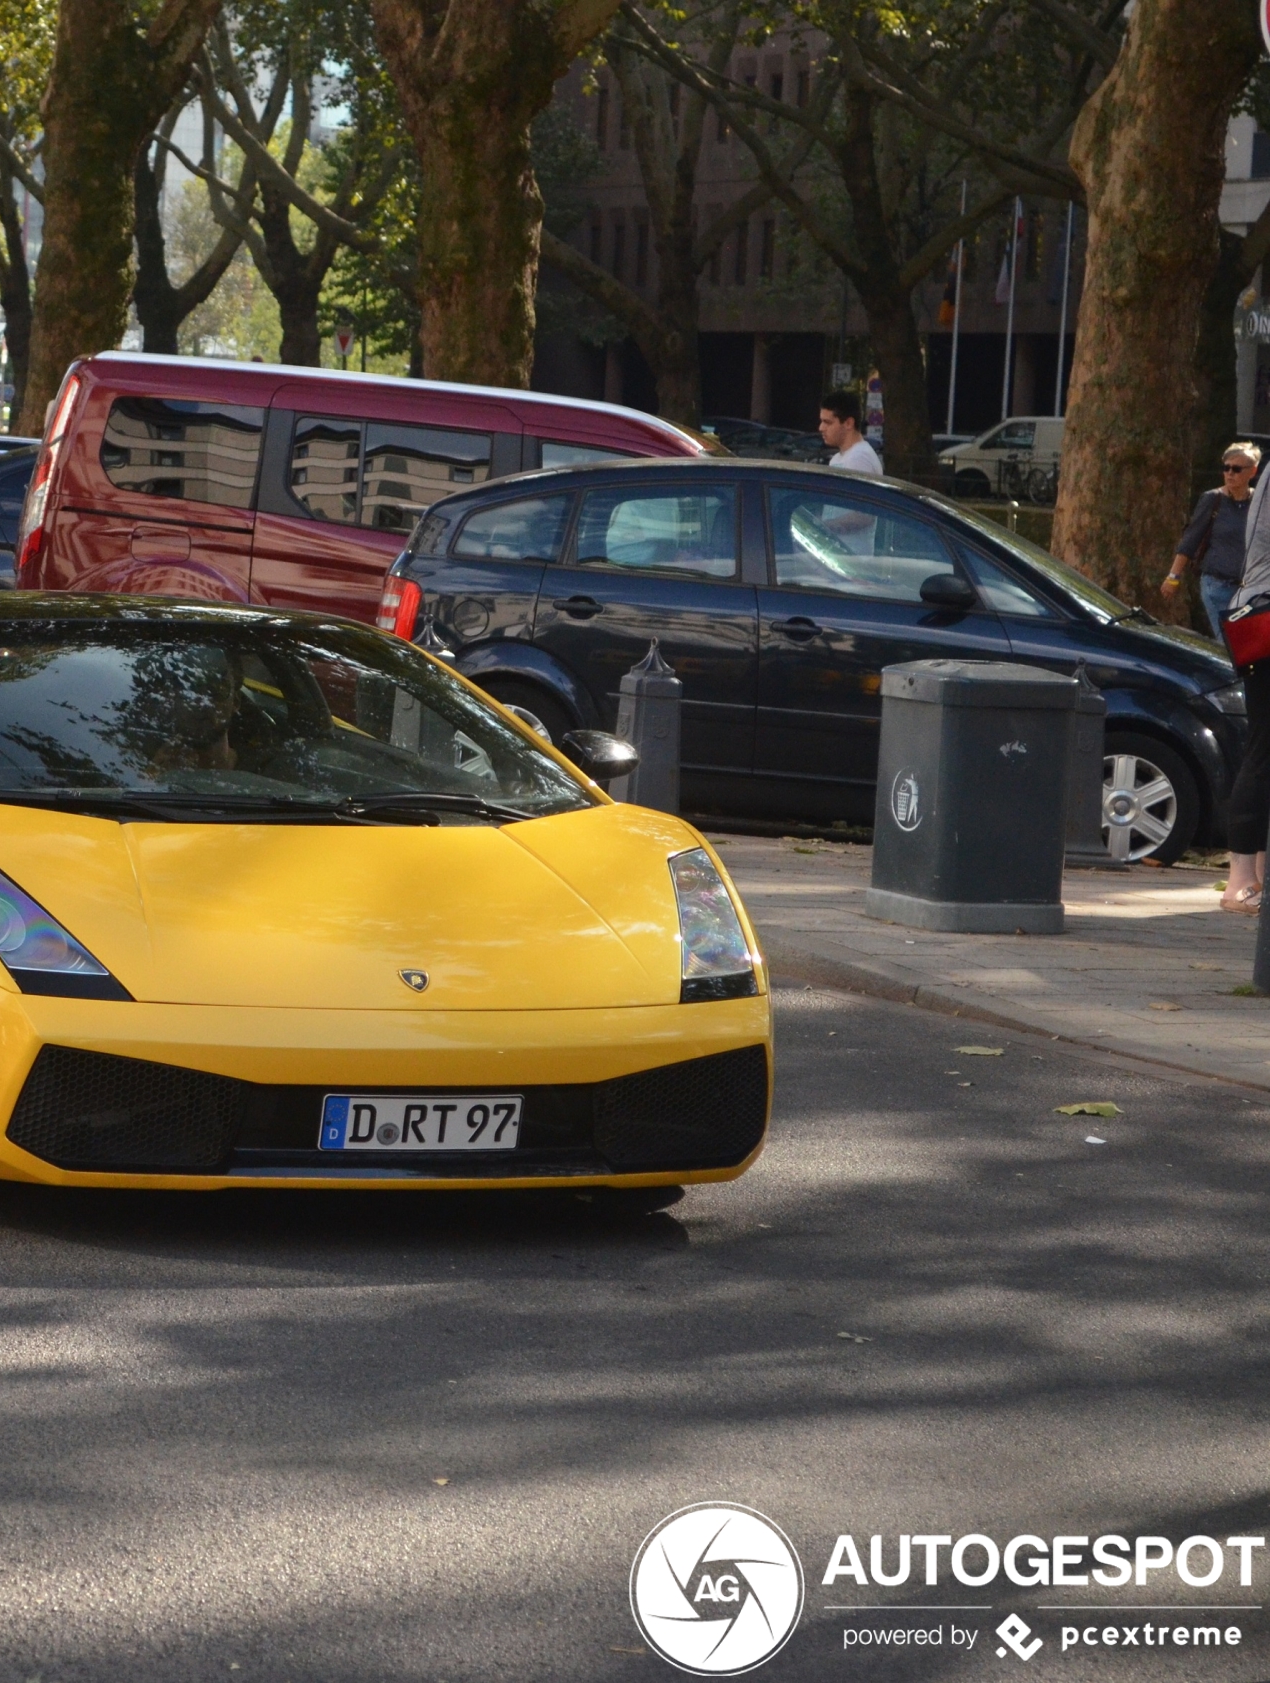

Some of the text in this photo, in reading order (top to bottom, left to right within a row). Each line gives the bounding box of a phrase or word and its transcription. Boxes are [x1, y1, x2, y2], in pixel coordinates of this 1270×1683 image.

[330, 1128, 339, 1140] D
[349, 1103, 517, 1143] D RT 97
